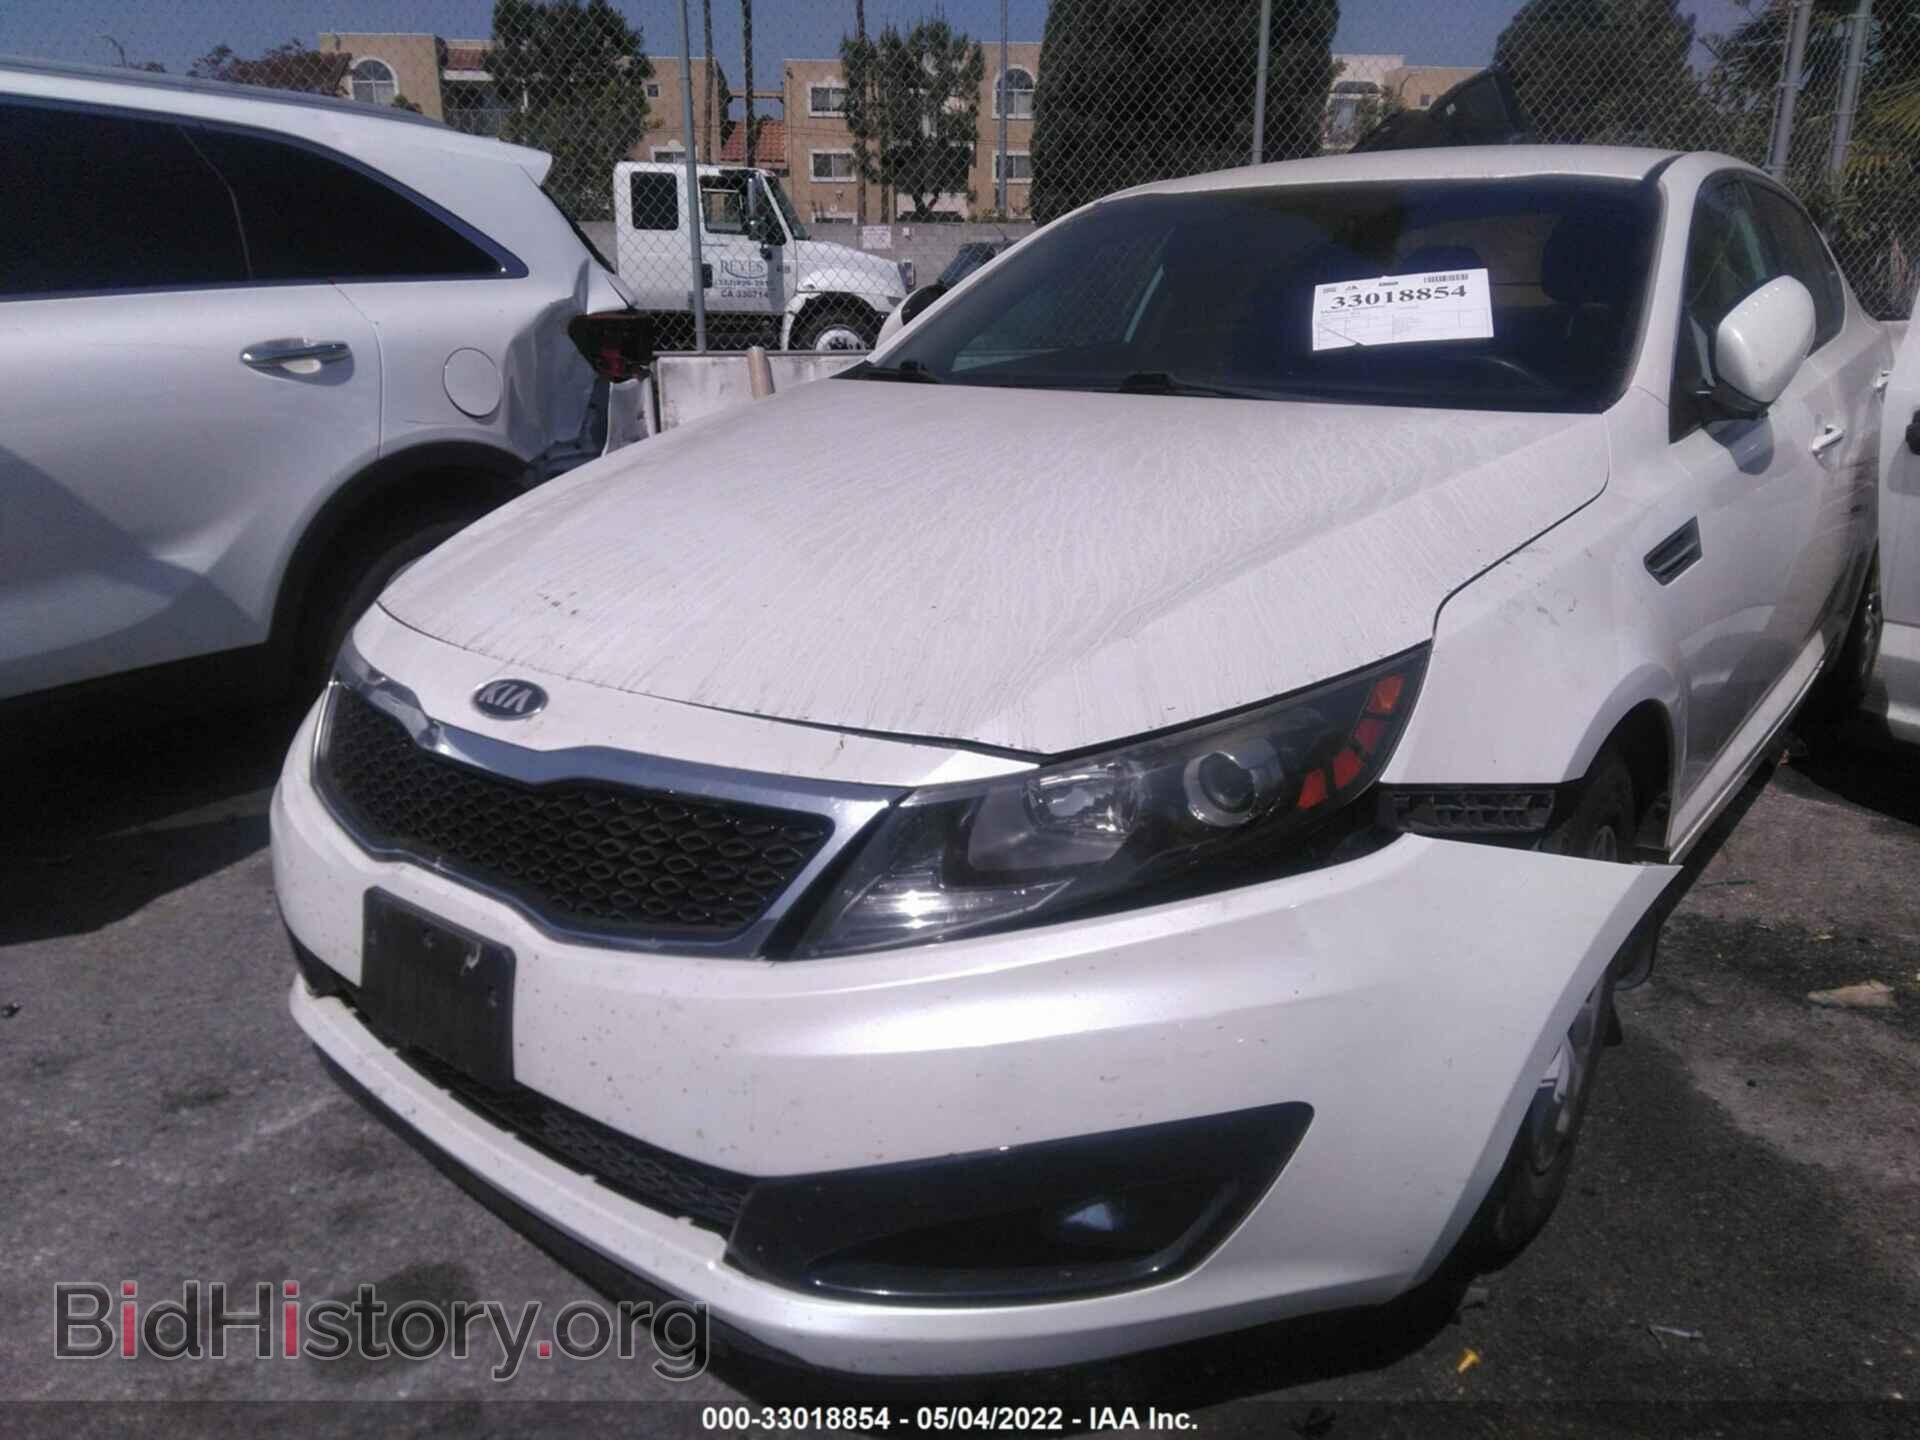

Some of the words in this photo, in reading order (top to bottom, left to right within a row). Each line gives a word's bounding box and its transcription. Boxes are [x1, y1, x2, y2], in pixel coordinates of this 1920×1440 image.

[720, 260, 765, 274] REYES
[721, 289, 733, 298] CA
[1330, 285, 1467, 310] 33018854
[480, 683, 533, 712] KIA
